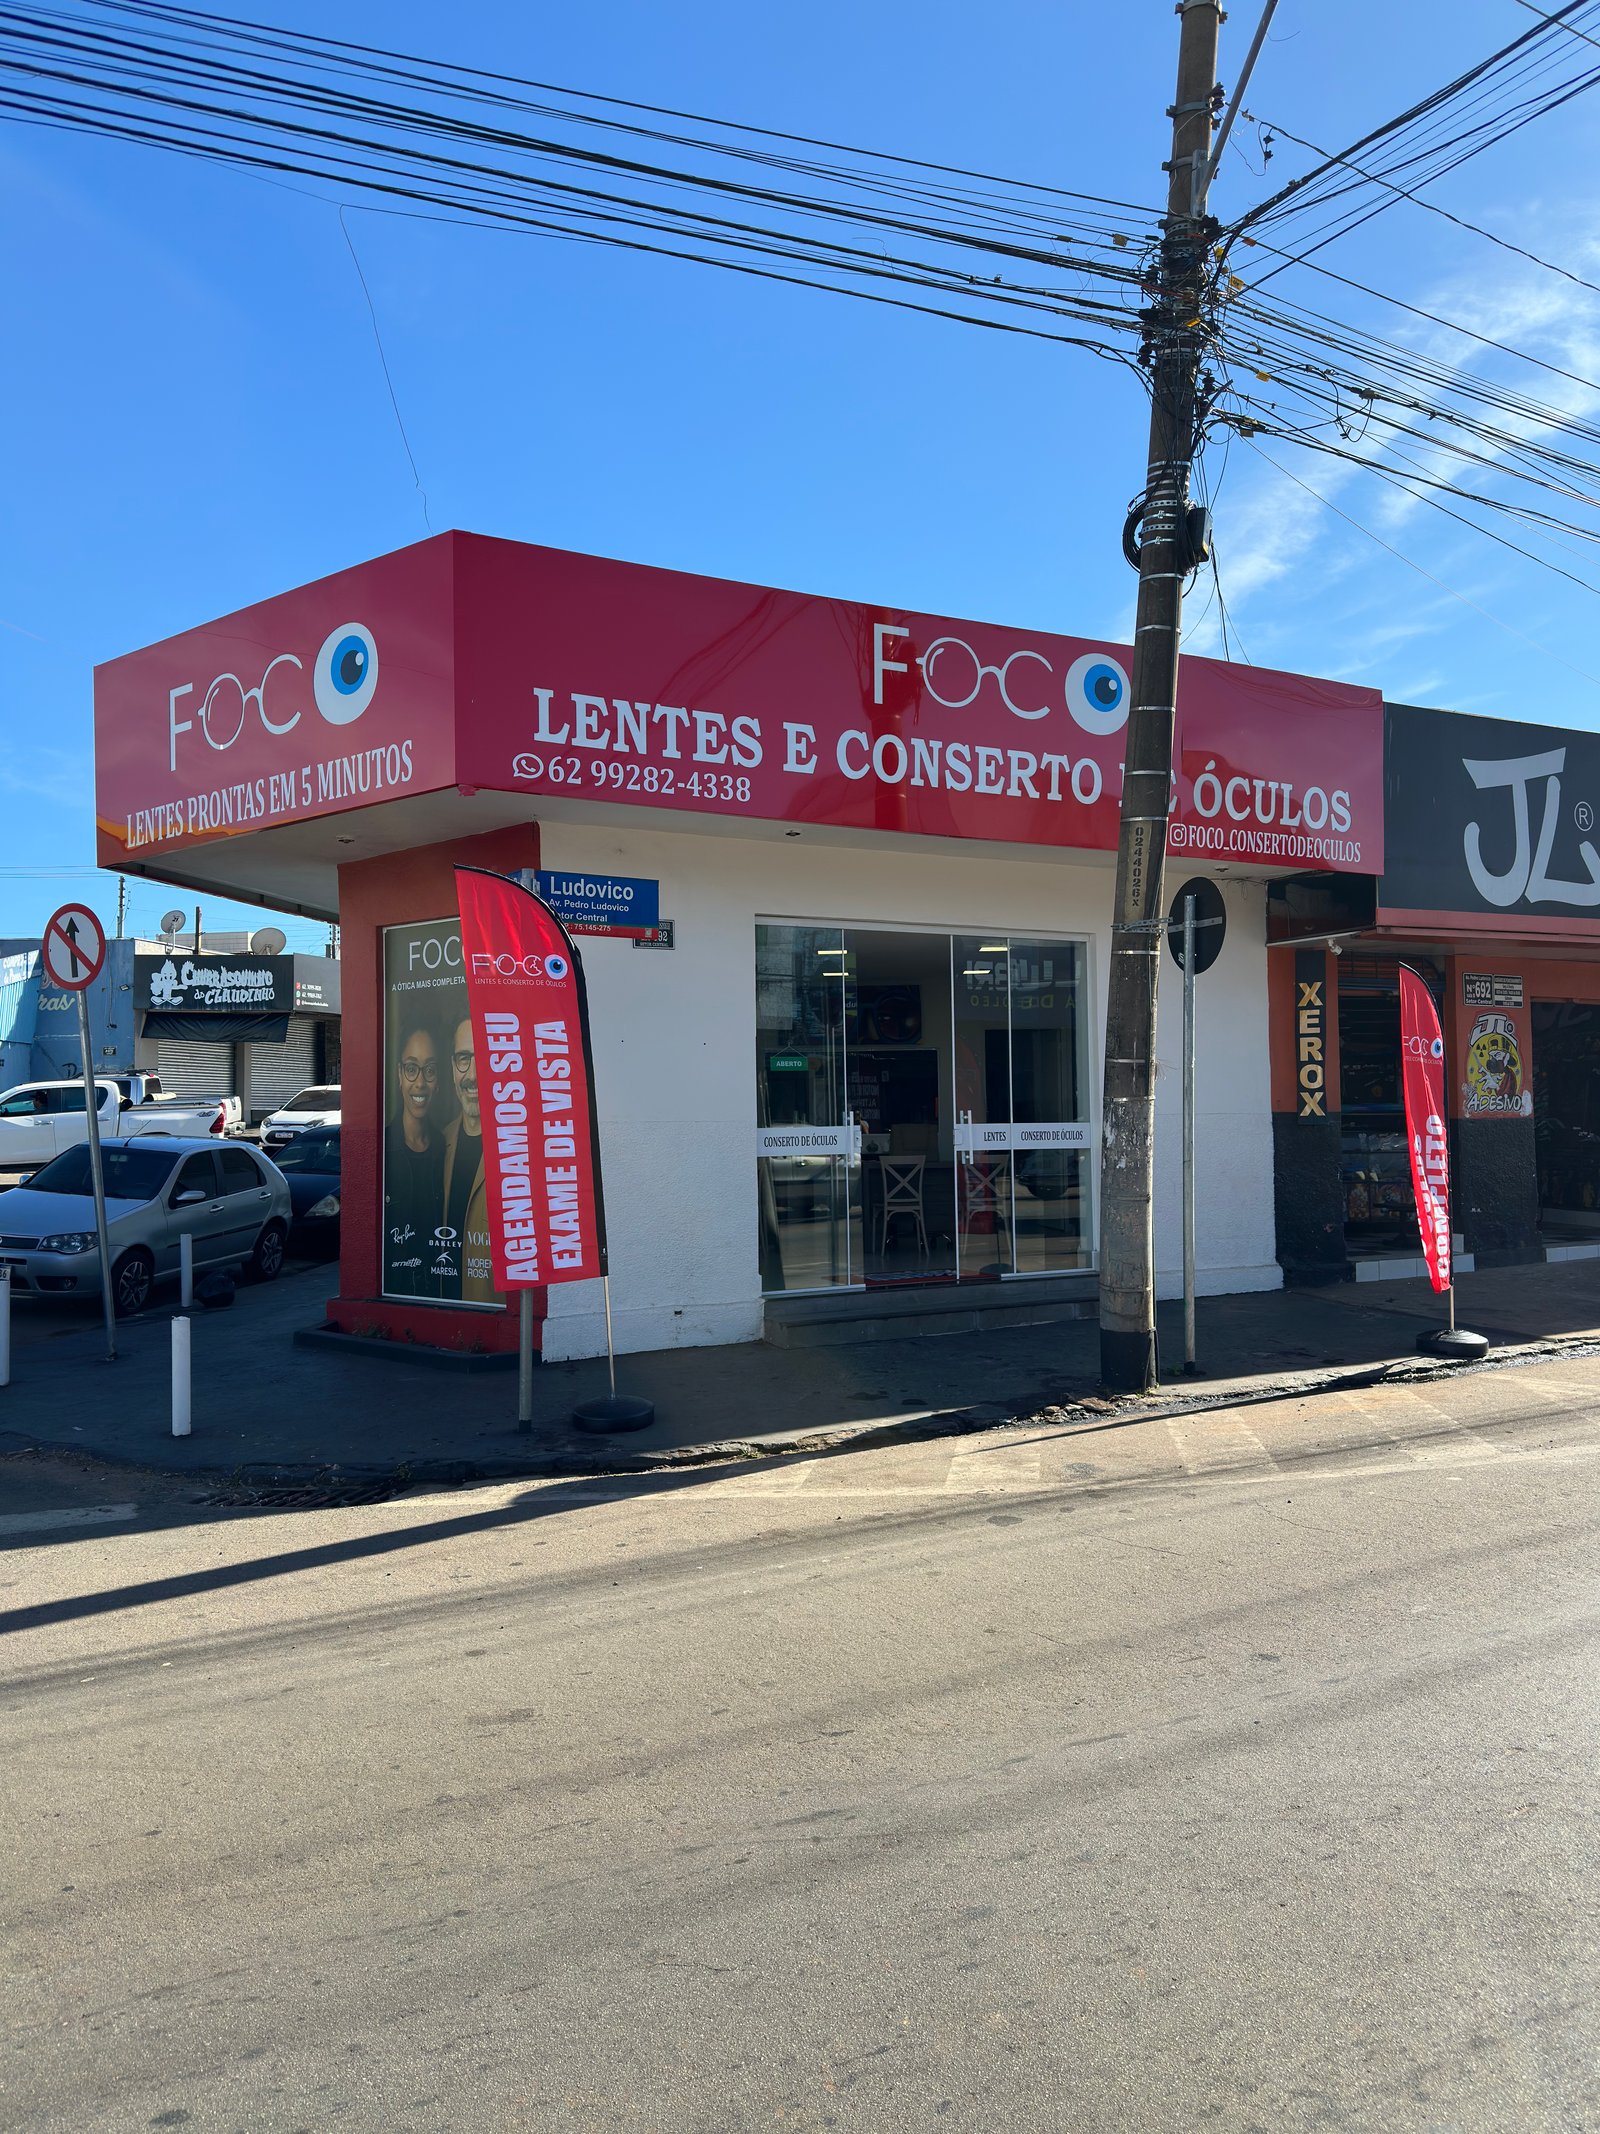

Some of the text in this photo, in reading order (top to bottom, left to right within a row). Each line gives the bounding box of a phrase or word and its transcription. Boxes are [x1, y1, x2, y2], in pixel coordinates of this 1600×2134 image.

[873, 622, 1132, 736] FOCO
[169, 622, 379, 772] FOCO
[533, 687, 763, 768] LENTES
[783, 721, 818, 774] E
[836, 729, 1102, 805] CONSERTO
[1193, 759, 1352, 833] ÓCULOS
[548, 756, 752, 802] 62 99282-4338
[126, 739, 414, 849] LENTES PRONTAS EM 5 MINUTOS
[1188, 825, 1361, 863] FOCO_CONSERTODEOCULOS
[550, 876, 634, 900] Ludovico
[550, 898, 629, 912] Av. Pedro Ludovico
[557, 912, 608, 923] tor Central
[408, 936, 466, 971] FOC
[472, 953, 568, 980] FOCO
[397, 981, 415, 991] ÓTICA
[416, 979, 431, 989] MAIS
[432, 976, 466, 987] COMPLETA
[503, 979, 534, 987] CONSERTO
[1475, 981, 1491, 998] 692
[1298, 981, 1325, 1117] XEROX
[764, 1132, 838, 1148] CONSERTO DE ÓCULOS
[983, 1131, 1007, 1143] LENTES
[1020, 1128, 1084, 1142] CONSERTO DE ÓCULOS
[484, 1013, 540, 1281] AGENDAMOS SEU
[534, 1020, 583, 1270] EXAME DE VISTA
[428, 1240, 463, 1248] OAKLEY
[467, 1231, 491, 1247] VOG
[430, 1266, 458, 1276] MARESIA
[467, 1258, 493, 1268] MOREN
[467, 1268, 489, 1278] ROSA
